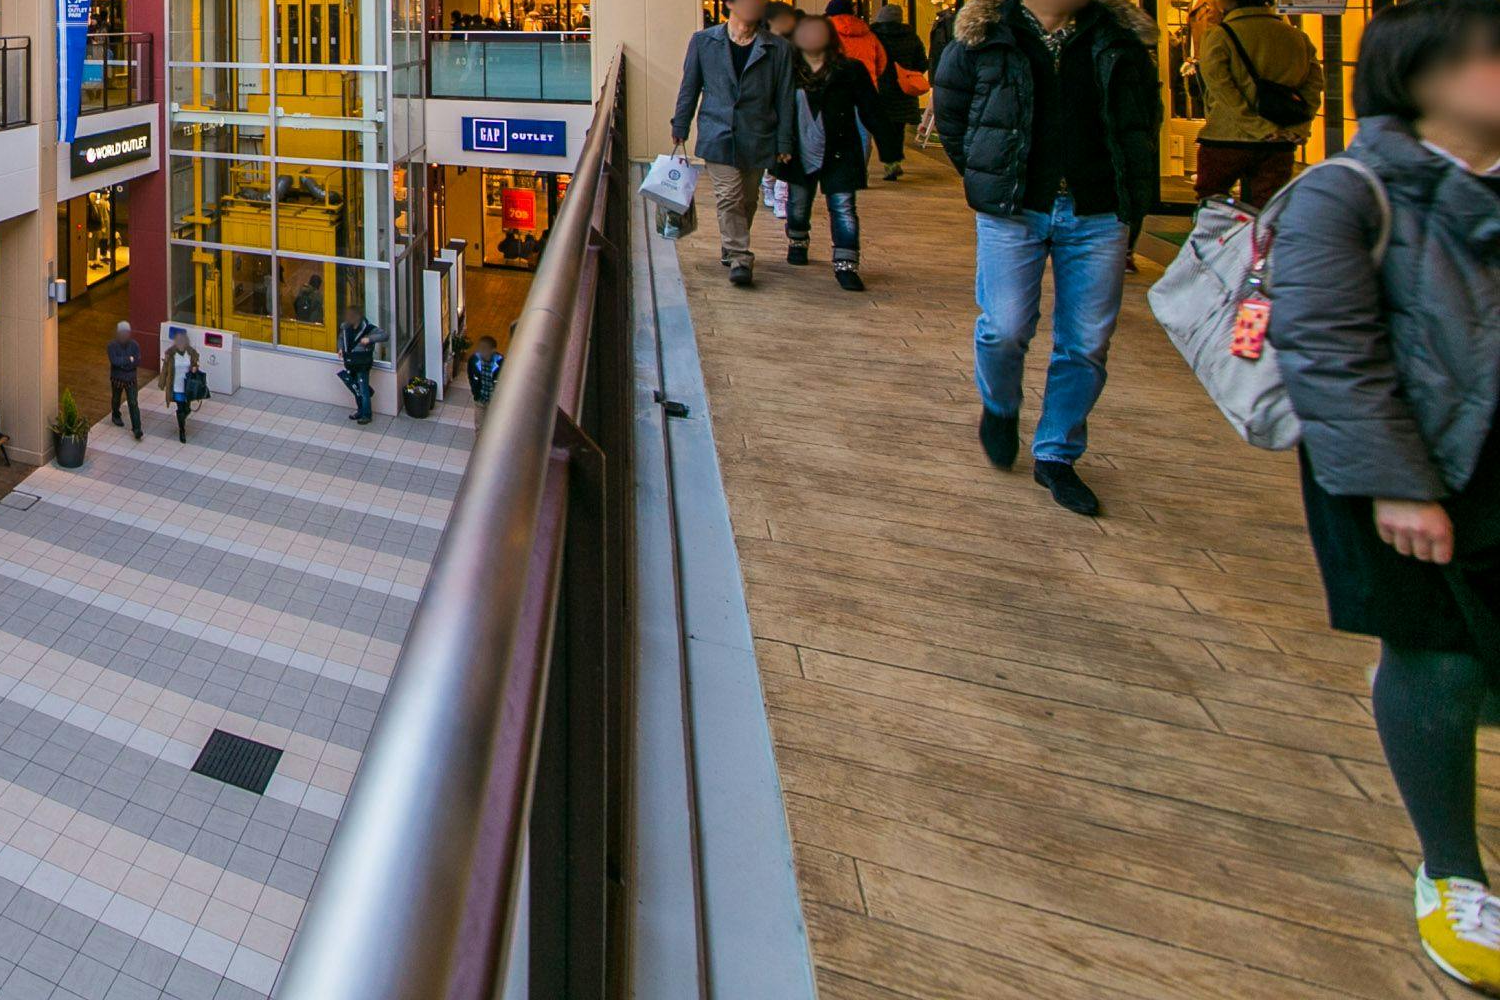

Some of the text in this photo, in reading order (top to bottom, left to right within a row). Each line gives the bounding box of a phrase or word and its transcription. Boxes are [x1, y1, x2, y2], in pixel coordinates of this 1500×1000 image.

[480, 127, 554, 142] GAP OUTLET
[95, 136, 148, 160] WORLD OUTLET
